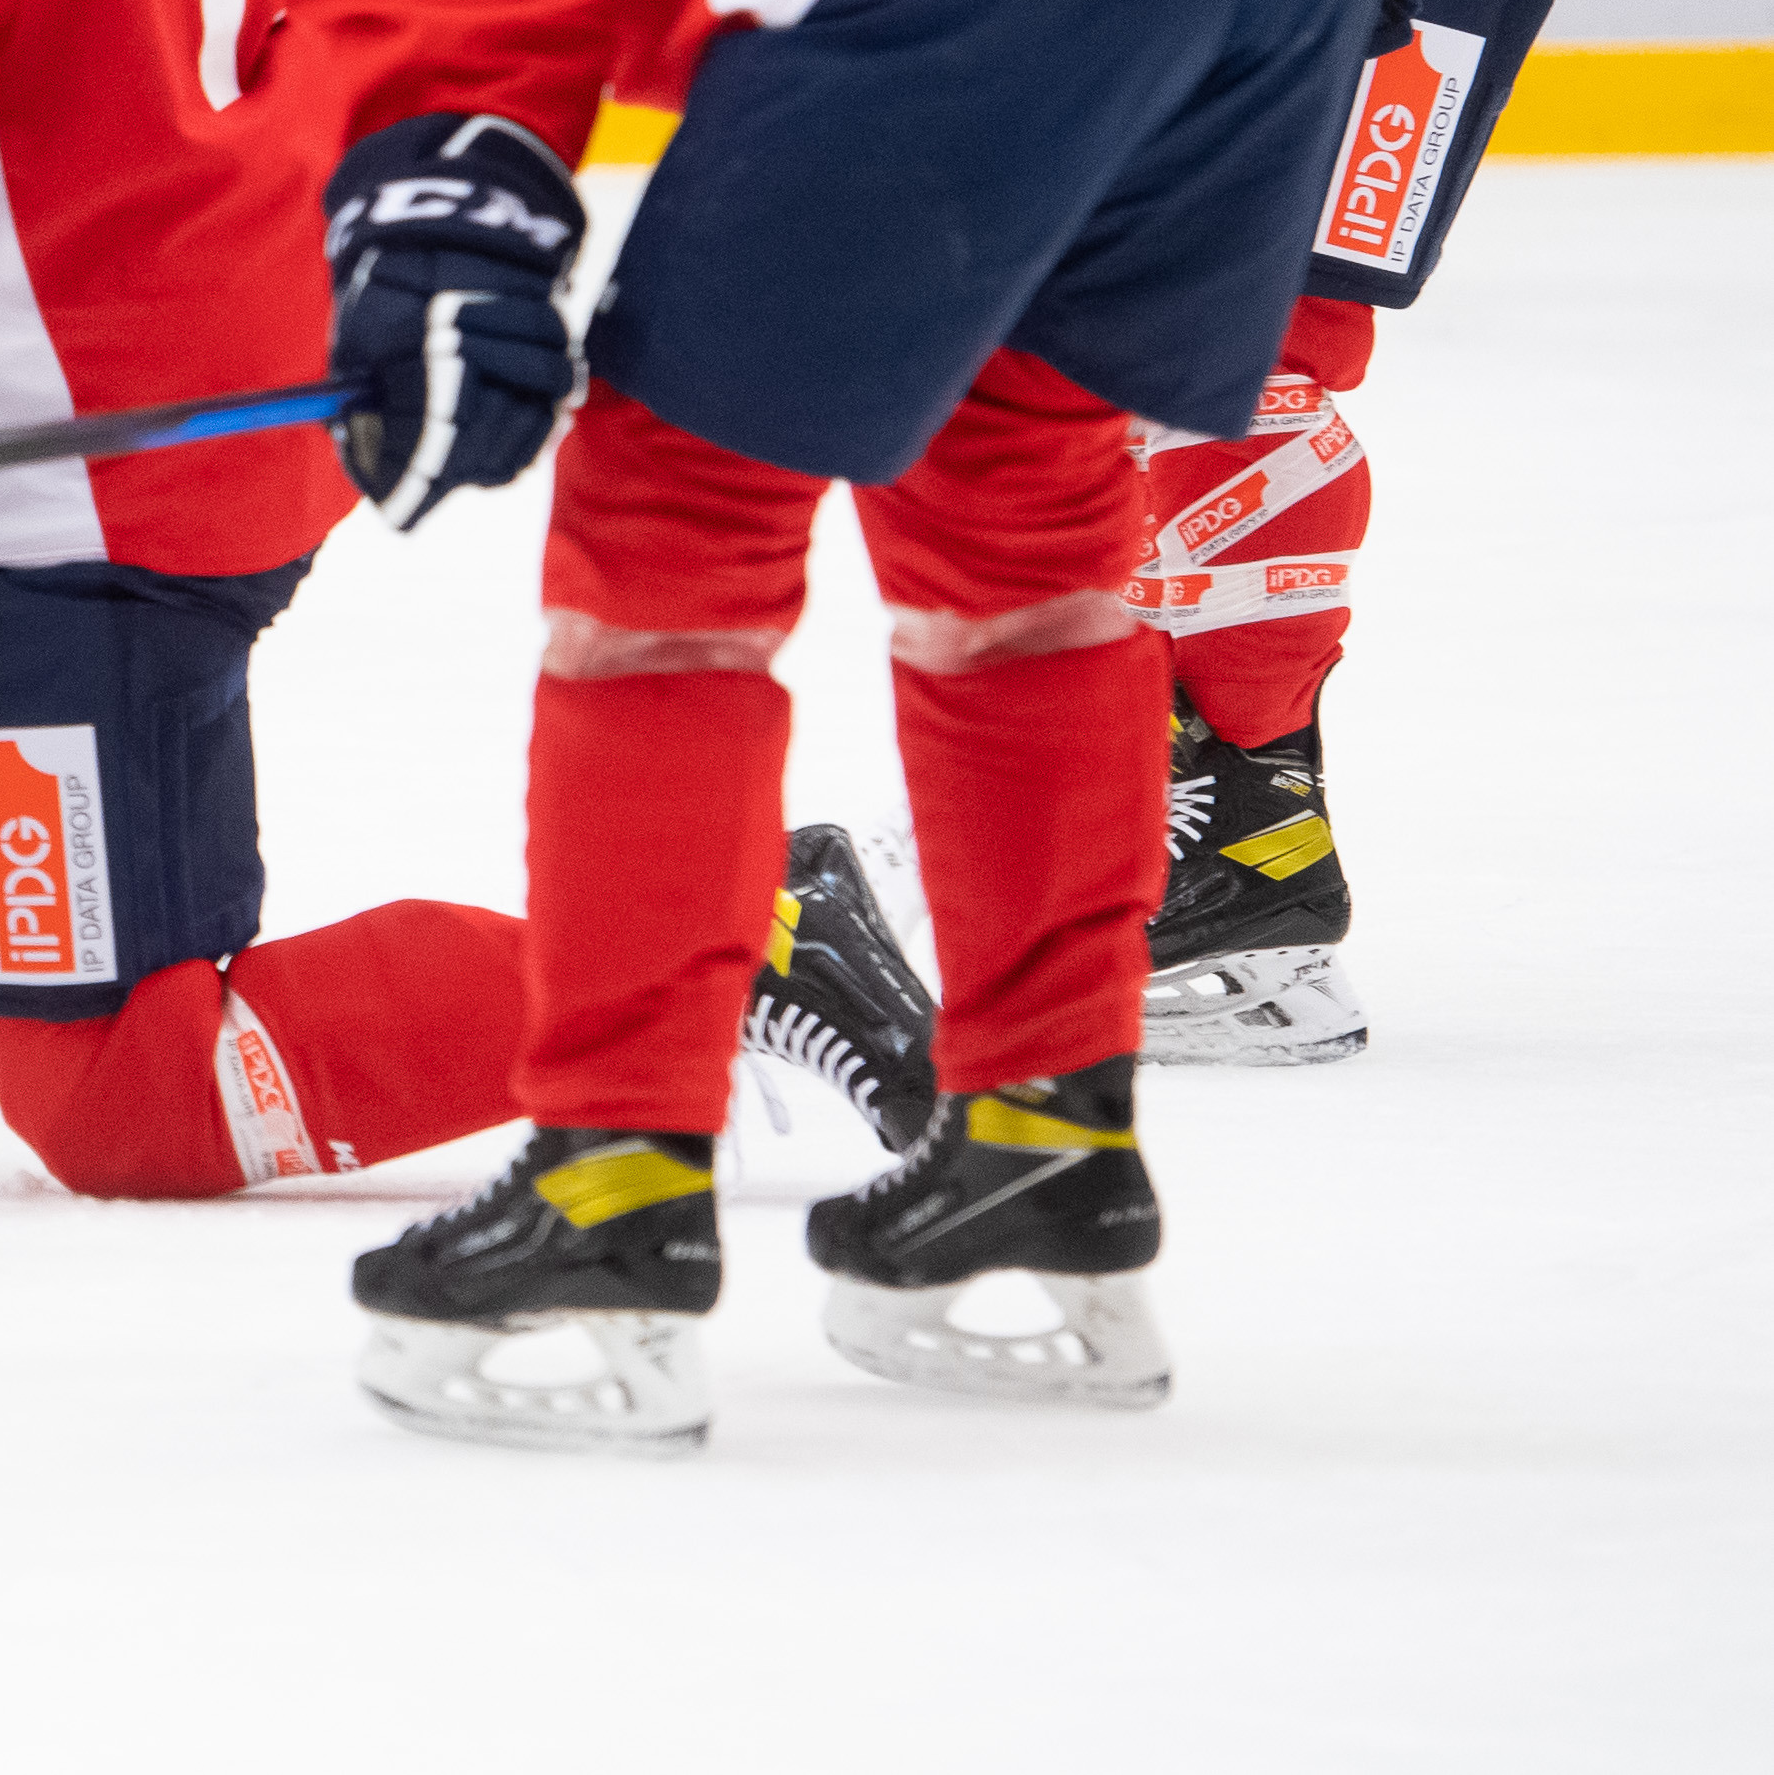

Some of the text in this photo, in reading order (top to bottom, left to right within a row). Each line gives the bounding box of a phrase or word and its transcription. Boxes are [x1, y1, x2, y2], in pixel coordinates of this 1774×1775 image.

[1391, 77, 1461, 262] IP DATA GROUP
[64, 773, 104, 973] IP DATA GROUP
